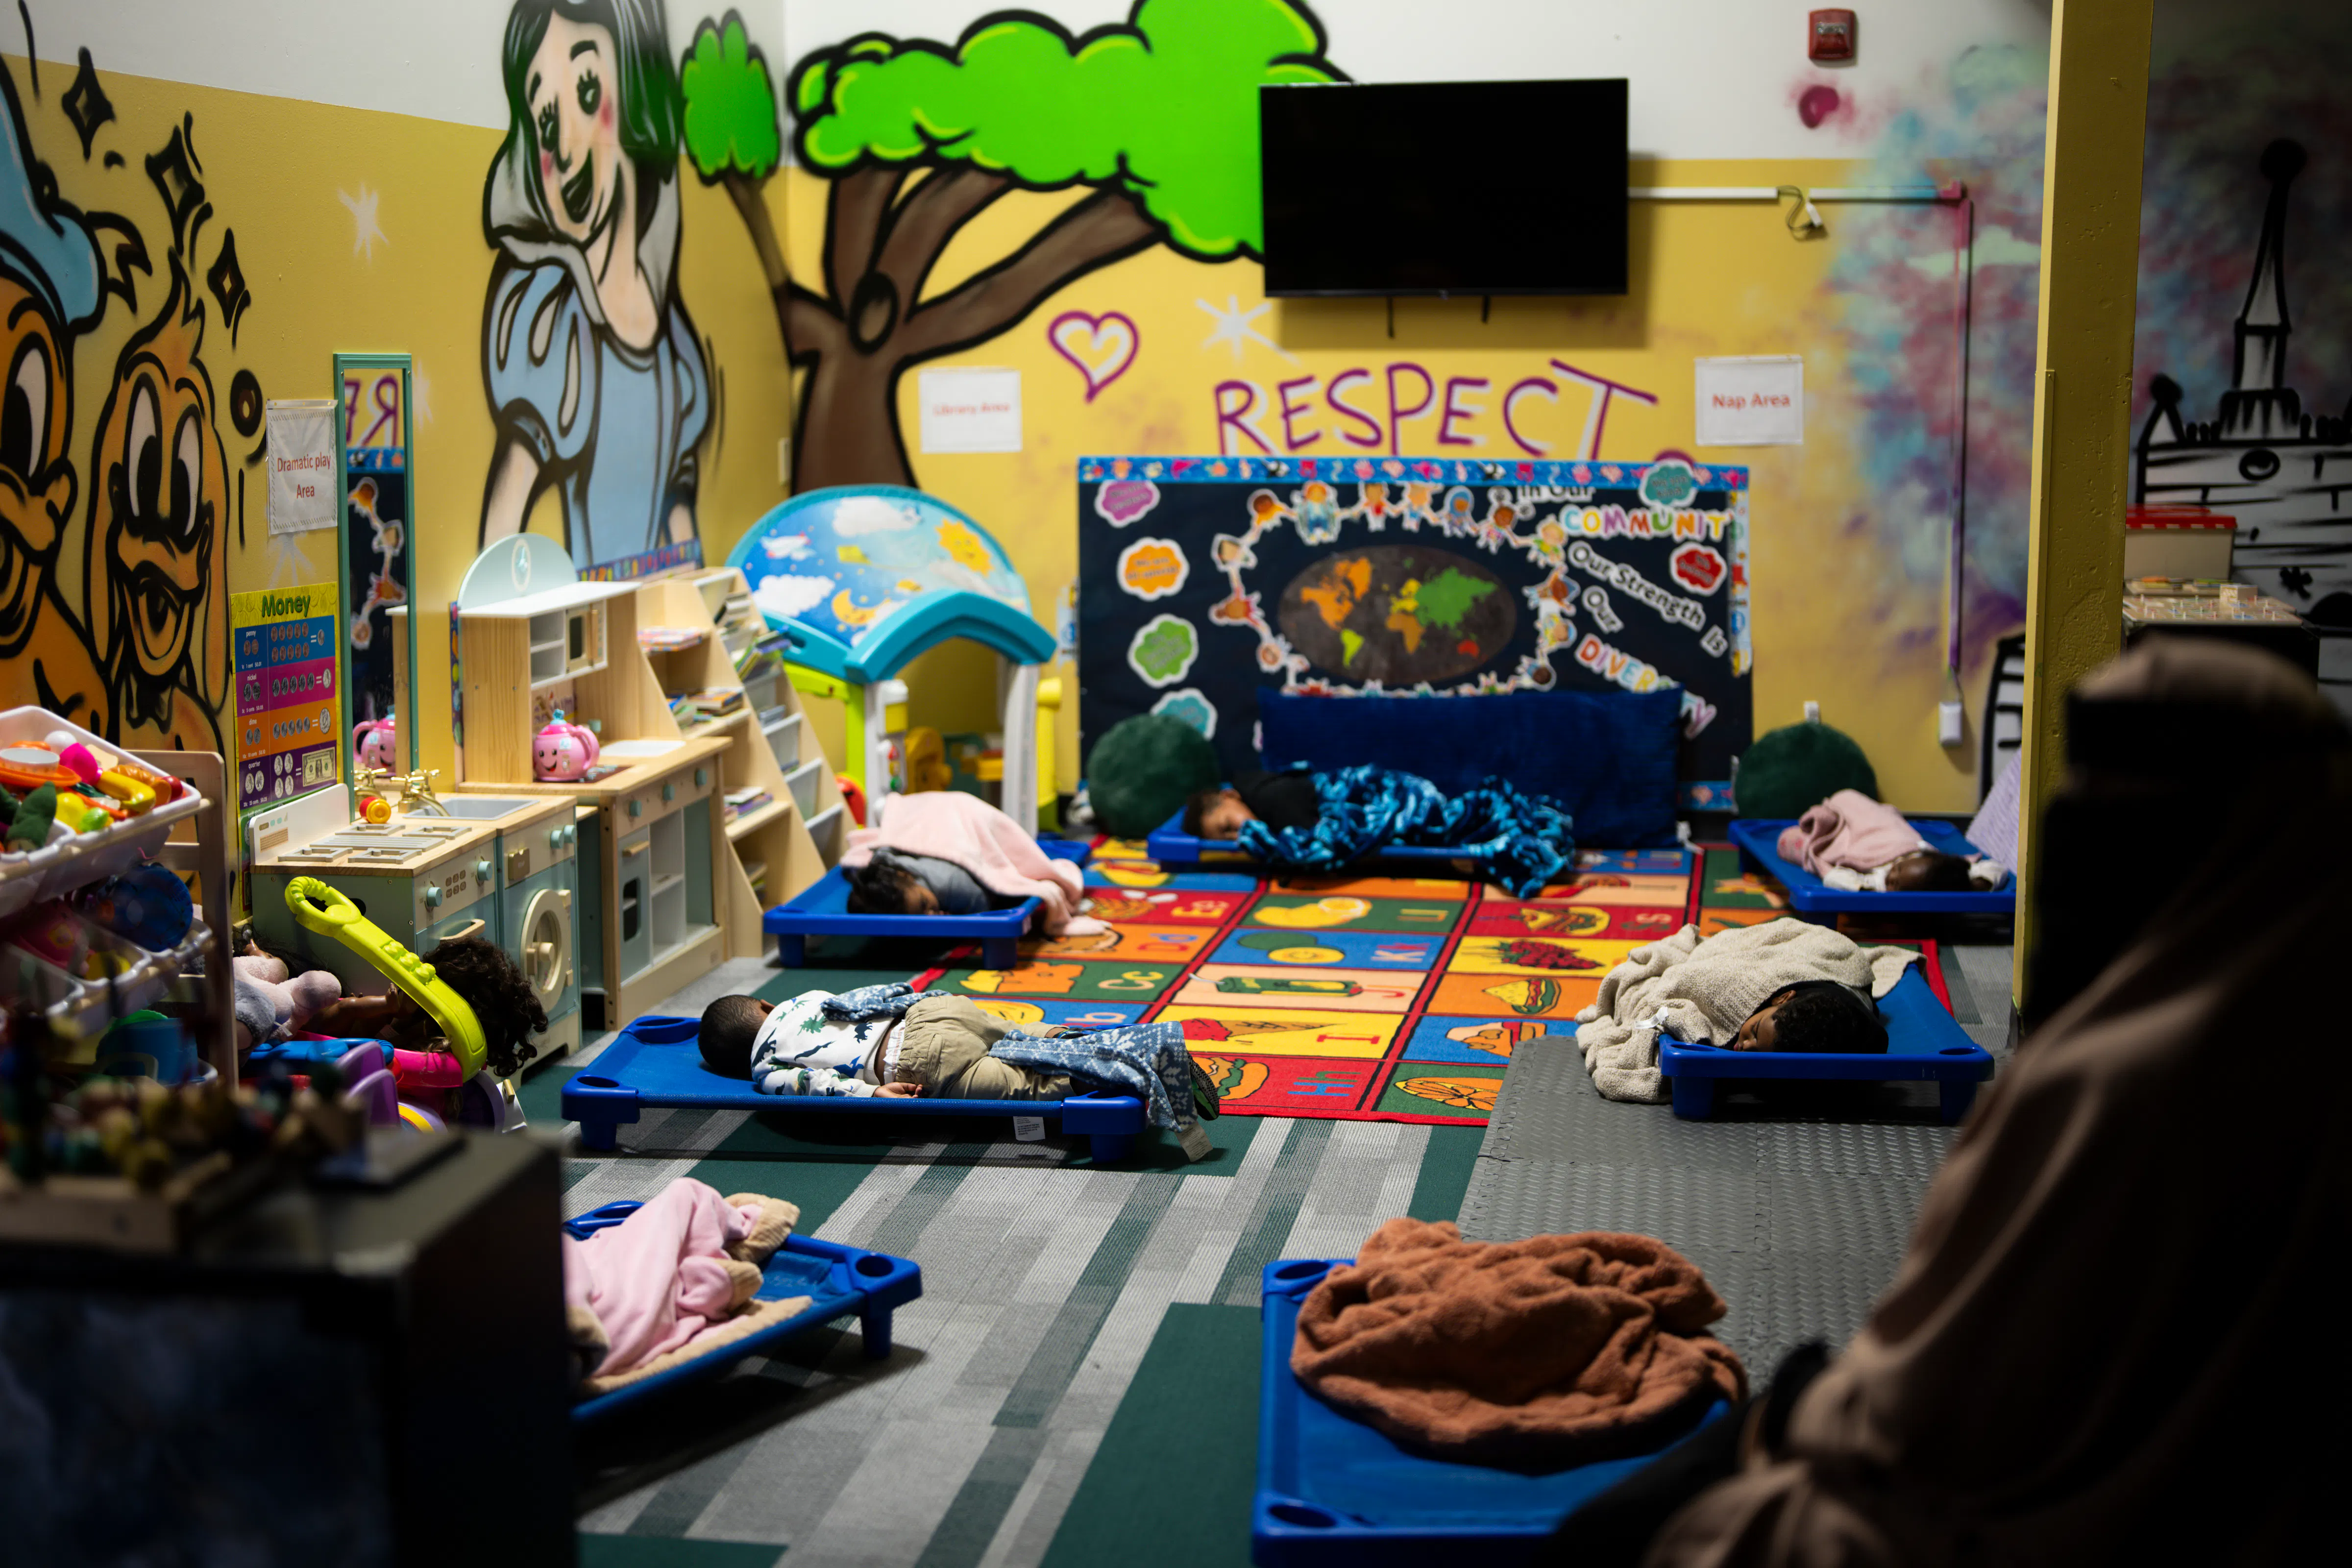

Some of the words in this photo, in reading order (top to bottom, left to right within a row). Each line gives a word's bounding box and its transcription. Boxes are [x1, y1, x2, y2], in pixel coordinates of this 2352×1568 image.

[1215, 358, 1658, 461] RESPECT
[1712, 393, 1746, 411] Nap
[1751, 392, 1791, 408] Area
[277, 454, 313, 472] Dramatic
[315, 452, 331, 471] play
[296, 484, 315, 499] Area
[1572, 545, 1611, 580] Our
[1617, 566, 1703, 626] Strength
[262, 595, 310, 617] Money
[1586, 590, 1617, 629] Our
[1707, 629, 1724, 652] Is
[248, 761, 260, 770] quarter
[1097, 971, 1164, 990] Cc
[1287, 1071, 1362, 1097] Hh
